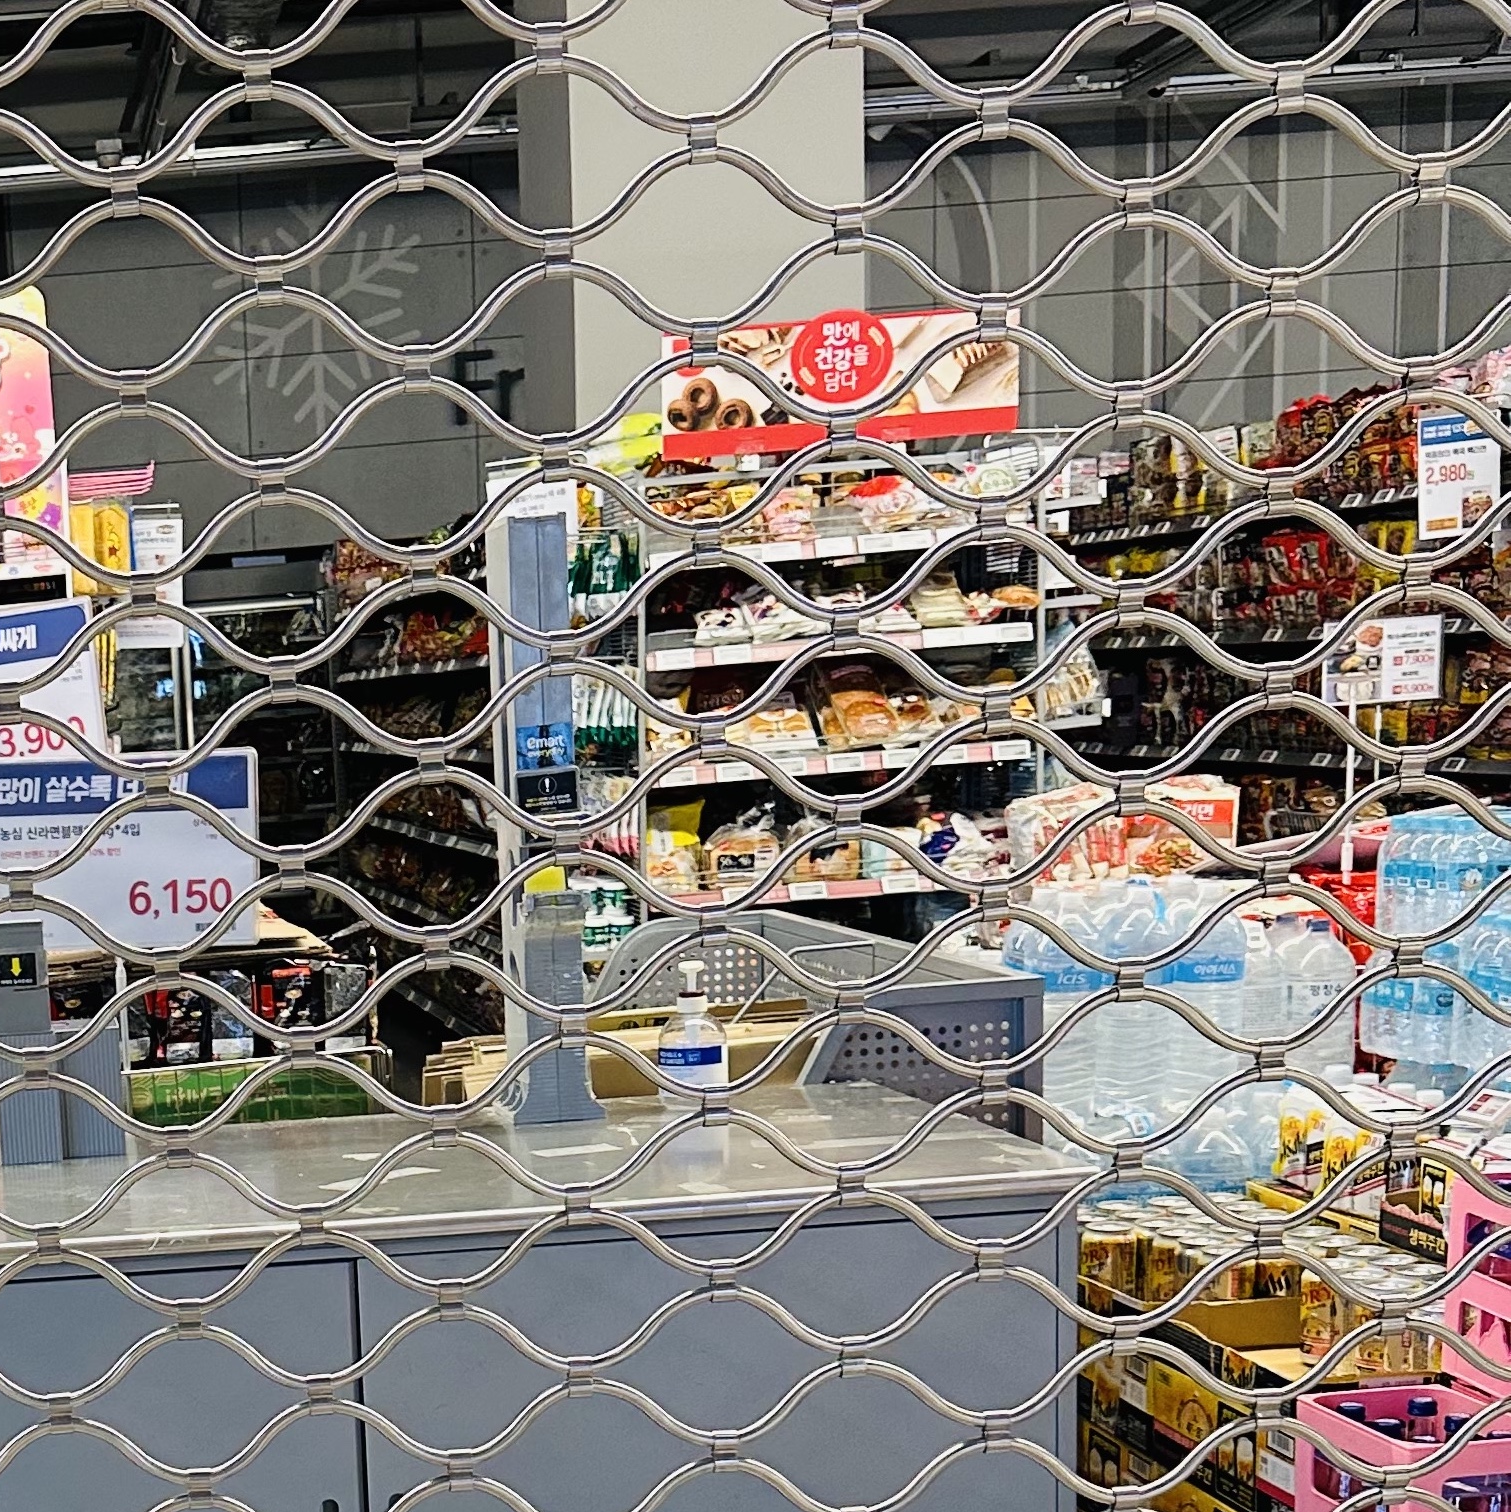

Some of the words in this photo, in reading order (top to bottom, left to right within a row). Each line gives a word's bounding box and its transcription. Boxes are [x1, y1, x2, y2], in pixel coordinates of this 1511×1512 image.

[822, 321, 860, 345] 맛에
[815, 346, 869, 371] 건강을
[824, 372, 857, 393] 담다
[45, 774, 112, 803] 살수록
[0, 826, 22, 841] 농심
[128, 877, 233, 919] 6,150
